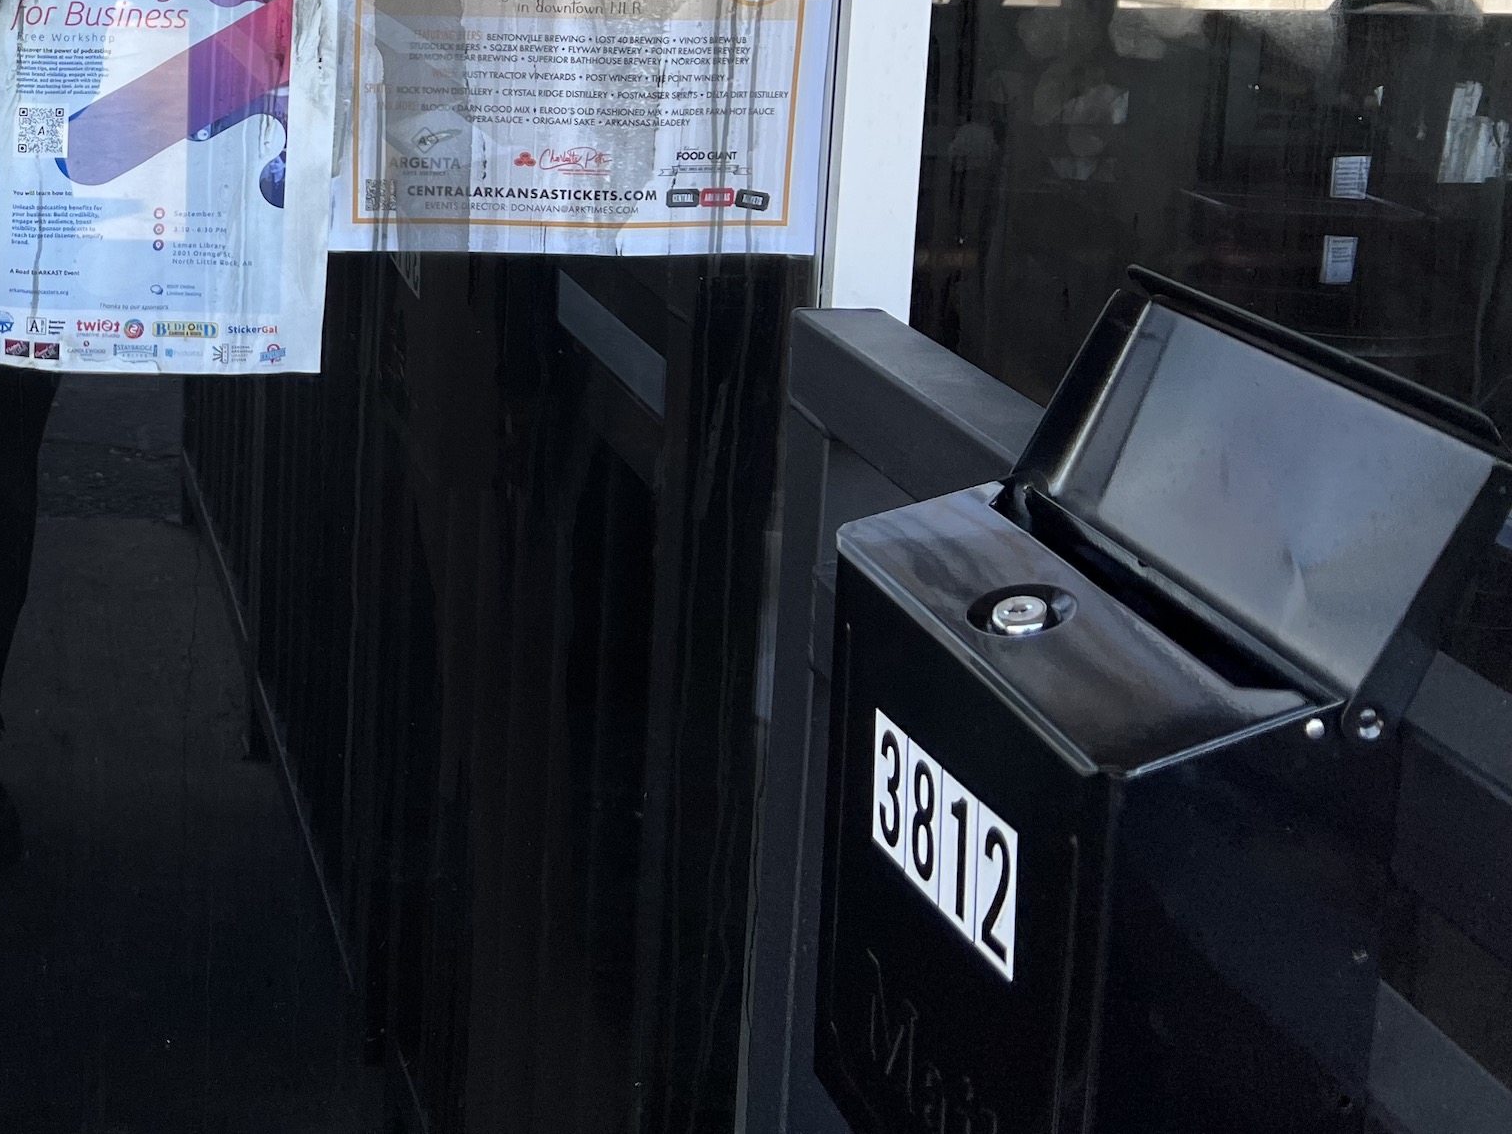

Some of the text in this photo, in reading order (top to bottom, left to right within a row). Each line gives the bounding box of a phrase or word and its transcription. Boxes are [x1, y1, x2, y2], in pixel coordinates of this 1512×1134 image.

[65, 1, 188, 29] Business
[17, 32, 115, 43] Free Workshop
[544, 34, 586, 44] BREWING
[595, 36, 616, 44] LOST
[617, 36, 628, 44] 40
[629, 36, 670, 45] BREWING
[502, 88, 608, 100] CRYSTAL RIDGE DISTILLERY
[532, 117, 596, 127] ORIGAMI SAKE
[676, 151, 737, 161] FOOD GIANT
[407, 185, 657, 202] CENTRALARKANSASTICKETS.COM
[511, 204, 639, 215] DONAVAN@ARKTIMES.COM
[228, 324, 278, 335] StickerGal
[878, 728, 1011, 964] 3812
